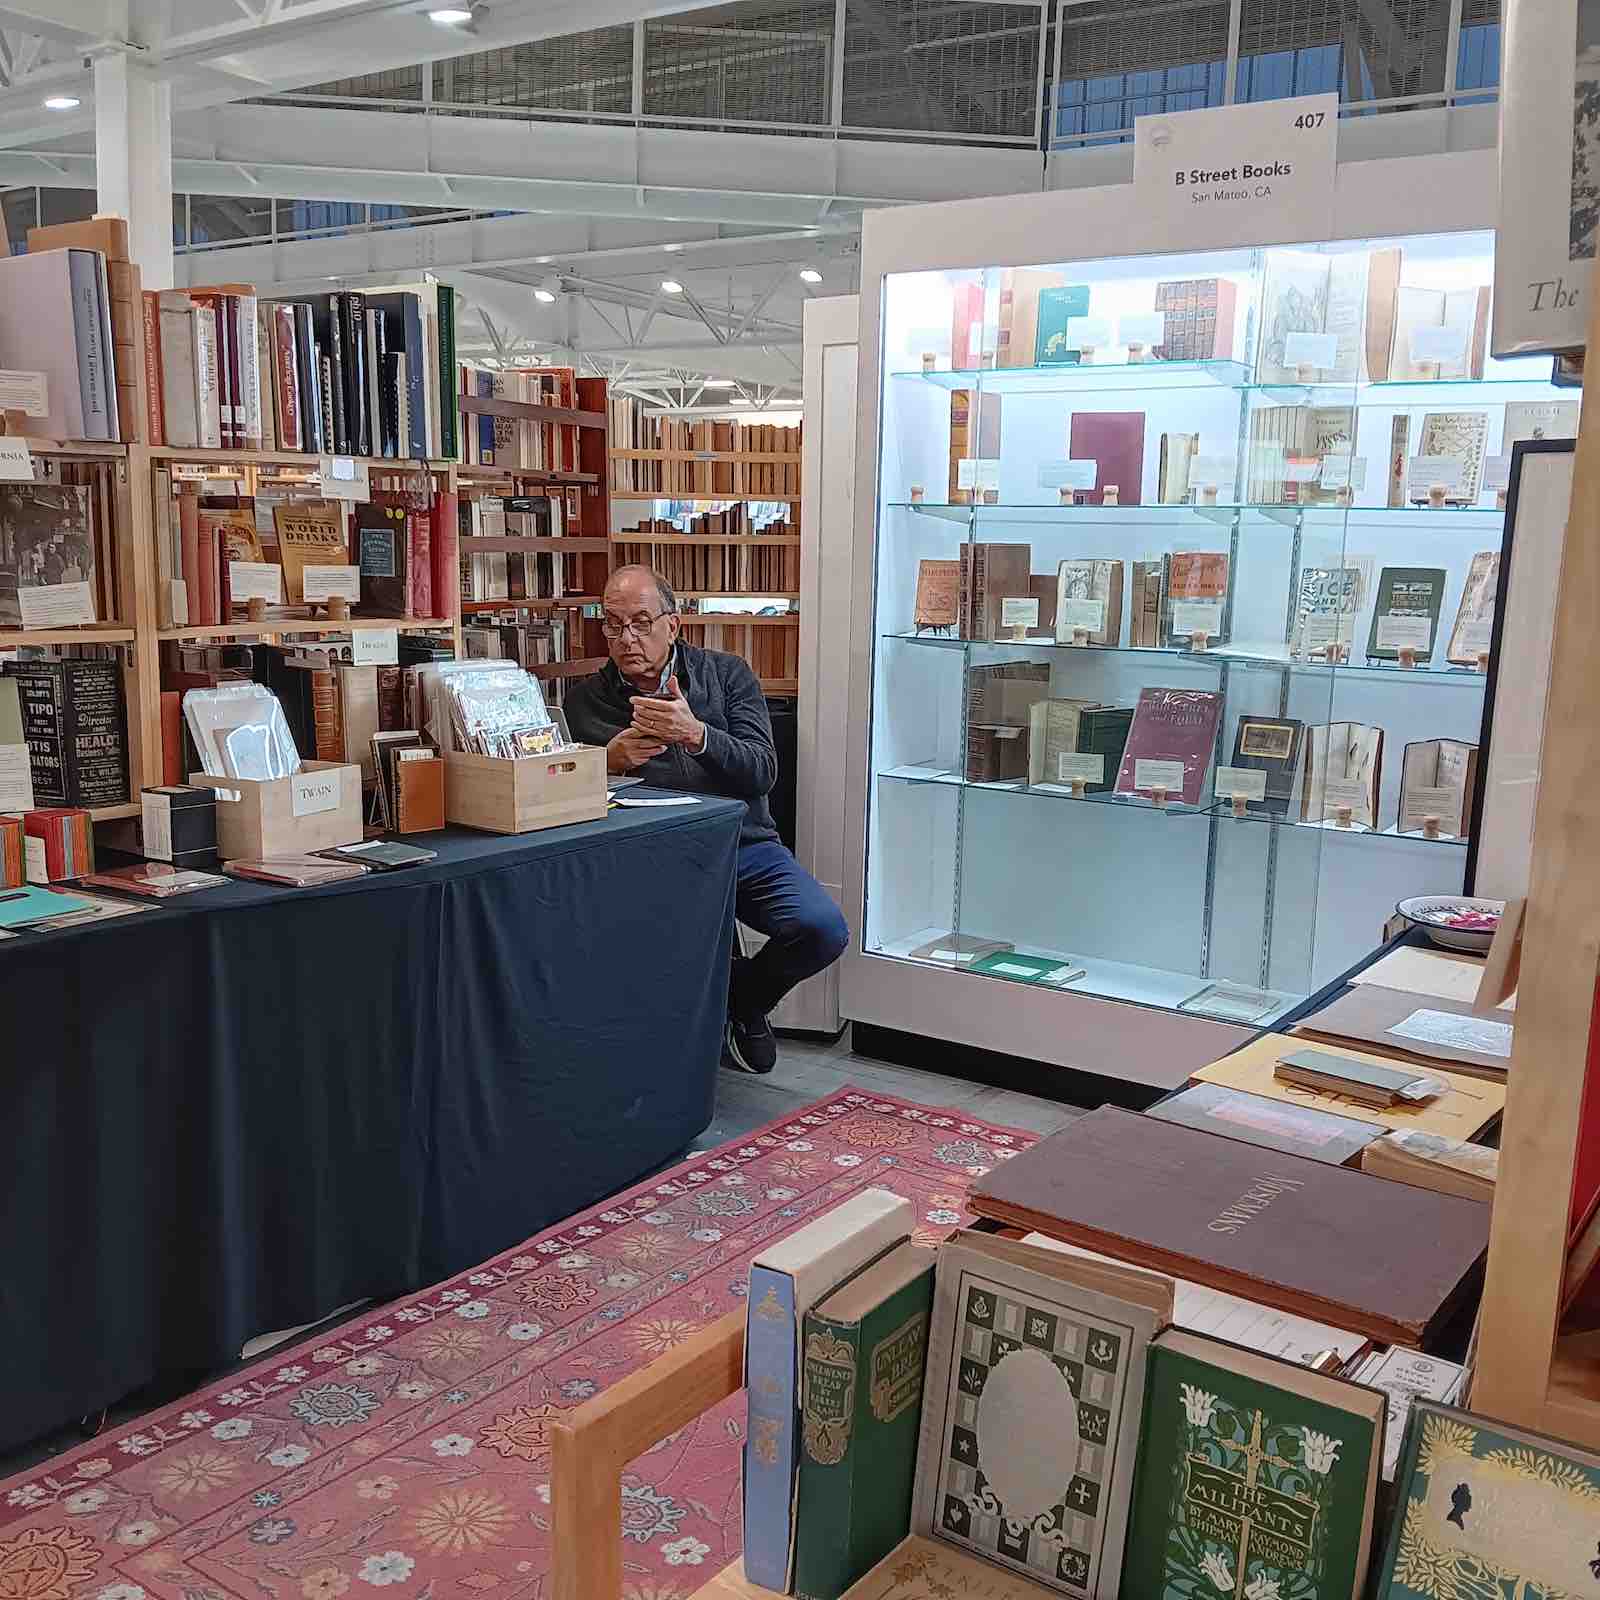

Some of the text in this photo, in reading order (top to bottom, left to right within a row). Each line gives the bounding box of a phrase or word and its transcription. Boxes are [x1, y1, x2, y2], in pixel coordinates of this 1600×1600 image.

[1294, 112, 1325, 130] 407
[1175, 160, 1292, 186] B Street Books
[1191, 191, 1211, 204] San
[1255, 186, 1272, 198] CA
[284, 523, 337, 534] WORLD
[285, 531, 338, 542] DRINKS
[28, 702, 54, 716] TIPO
[27, 740, 51, 752] OTIS
[1231, 1481, 1269, 1508] THE
[1191, 1482, 1305, 1539] MILITANTS
[1189, 1504, 1305, 1561] BY MARY RAYMOND
[1190, 1516, 1305, 1569] SHIPMAN ANDREWS
